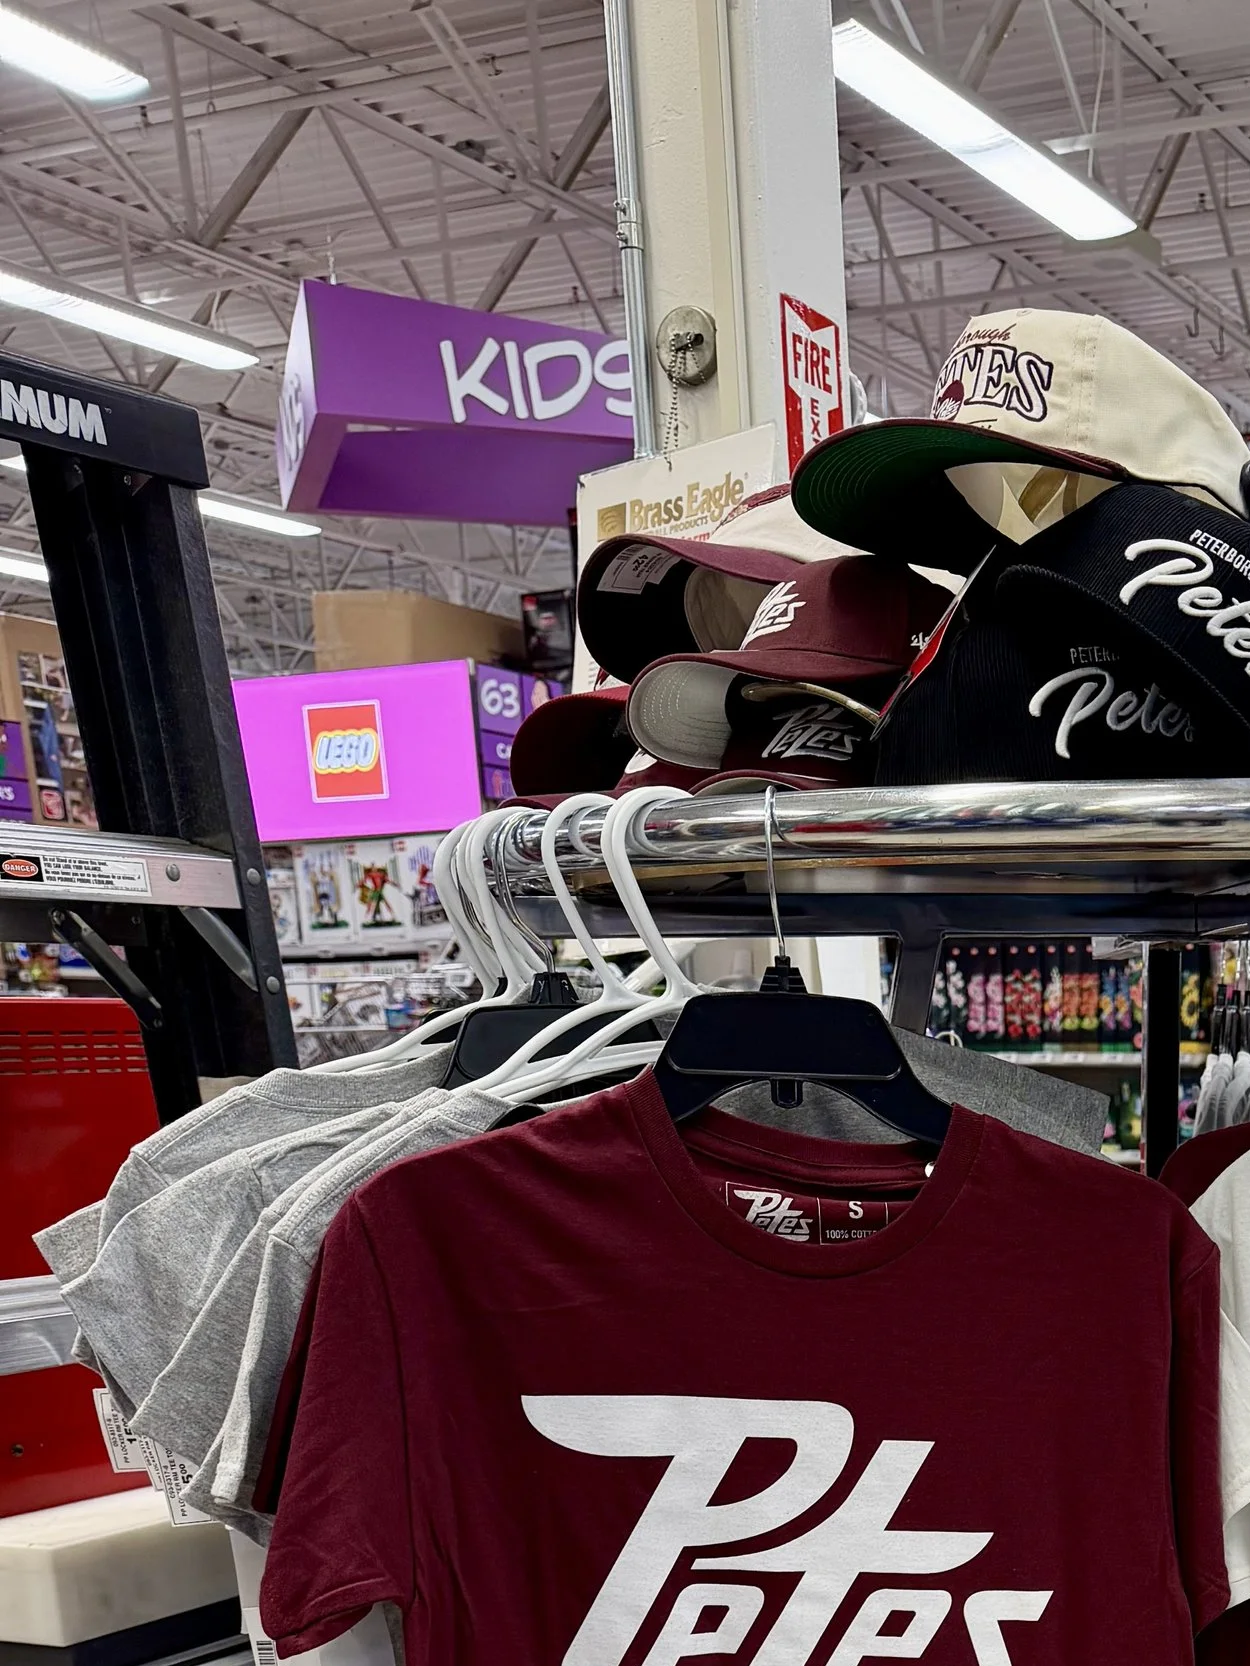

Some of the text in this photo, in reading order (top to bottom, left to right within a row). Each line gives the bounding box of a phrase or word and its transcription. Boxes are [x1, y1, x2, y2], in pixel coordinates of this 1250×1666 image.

[440, 338, 633, 424] KIDS
[792, 332, 832, 394] FIRE
[811, 397, 821, 444] EX
[629, 471, 745, 532] Brass Eagle
[669, 516, 708, 535] PRODUCTS
[1070, 646, 1120, 665] PETER
[481, 679, 520, 718] 63
[1029, 667, 1195, 760] Petes
[316, 733, 375, 770] LEGO
[4, 862, 37, 873] DANGER
[848, 1200, 864, 1219] S
[825, 1229, 878, 1240] 100% COTT
[118, 1433, 129, 1455] LOCKER
